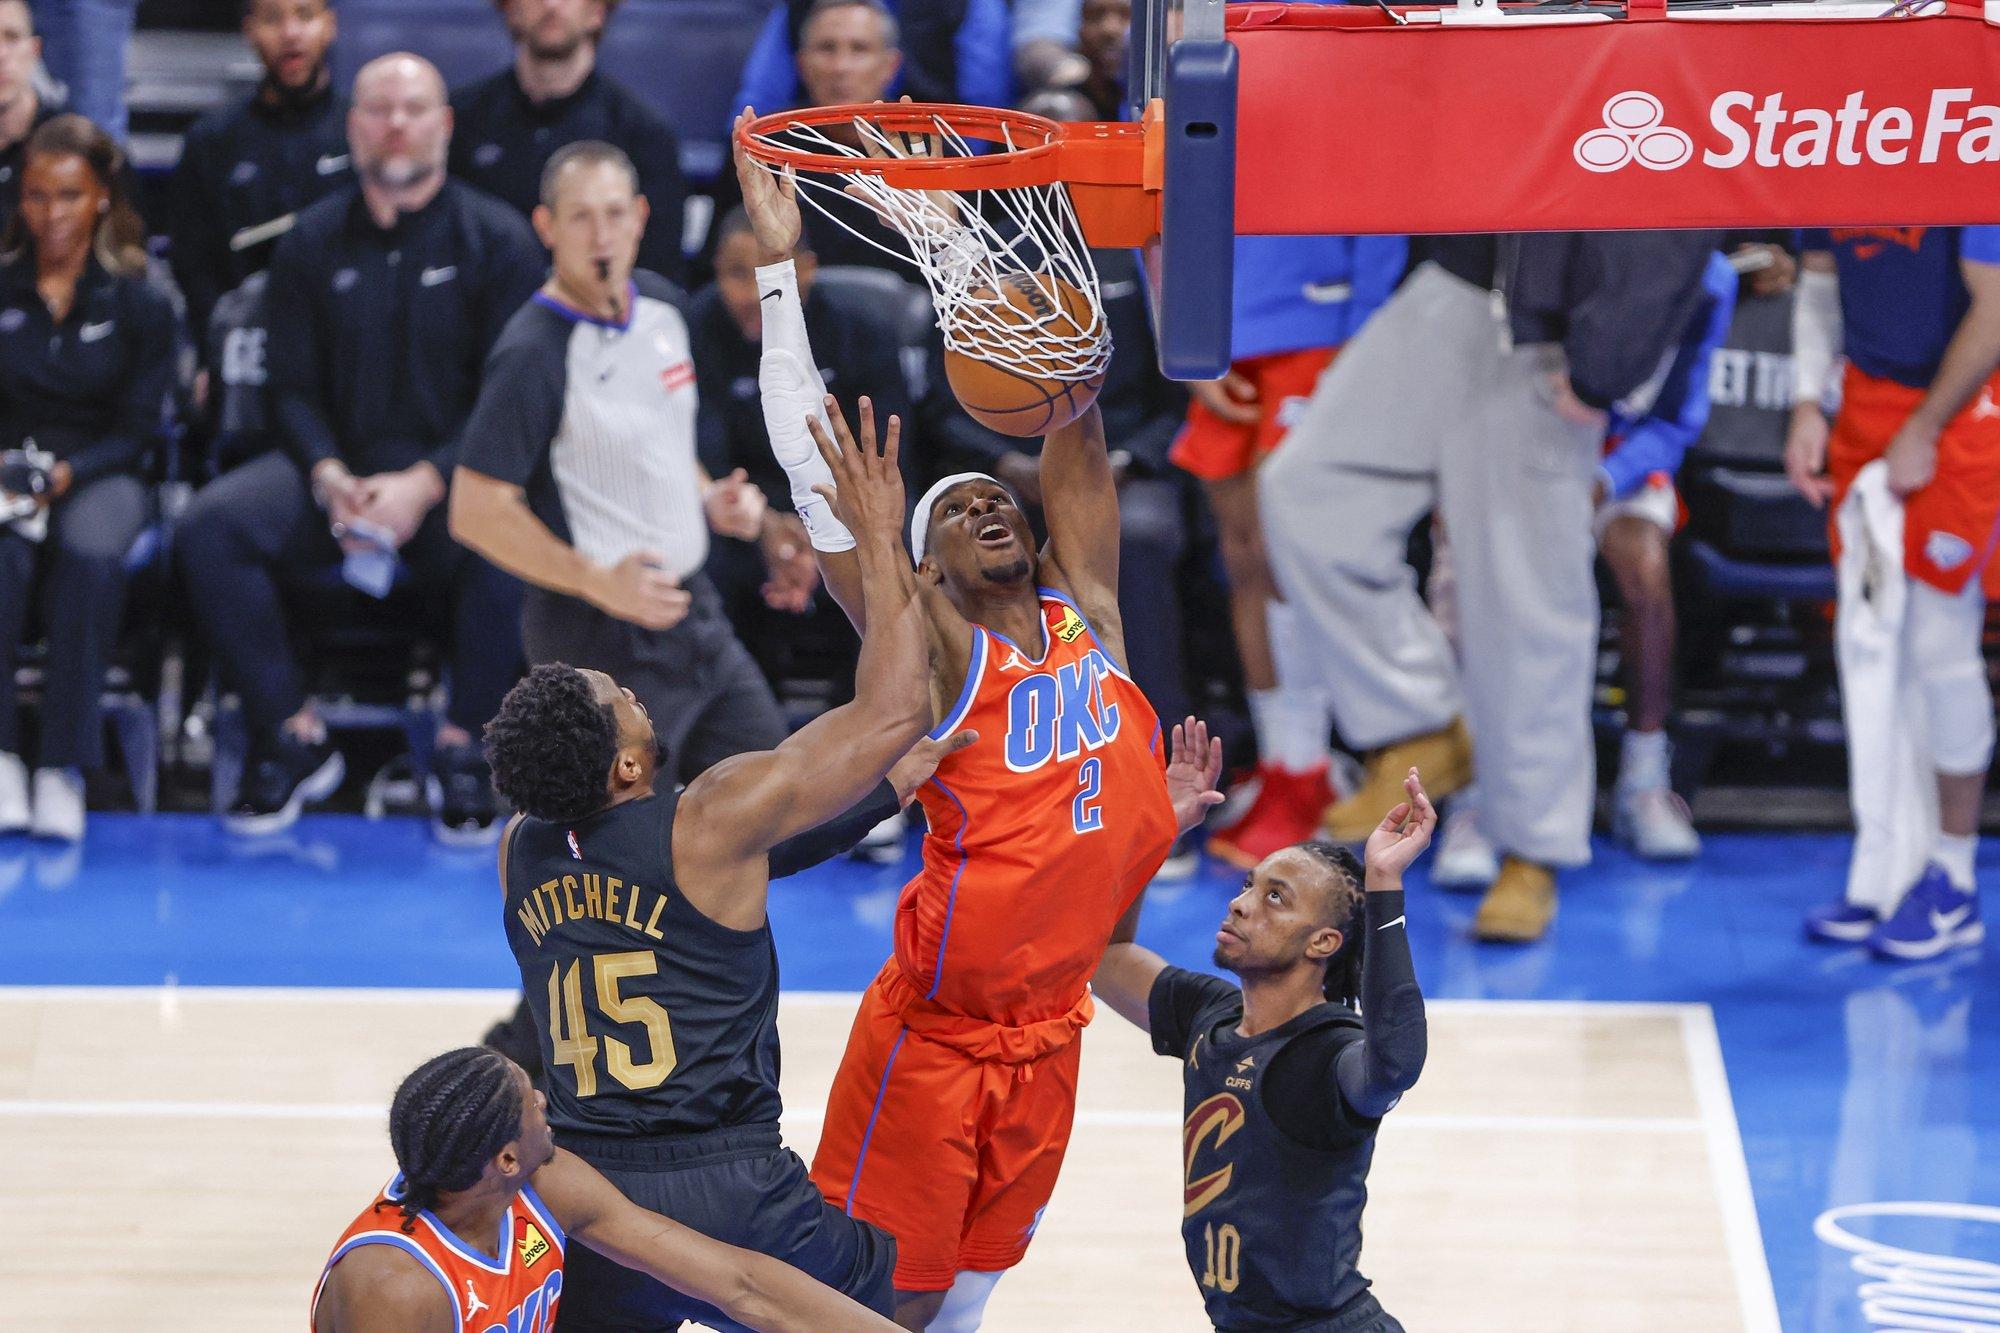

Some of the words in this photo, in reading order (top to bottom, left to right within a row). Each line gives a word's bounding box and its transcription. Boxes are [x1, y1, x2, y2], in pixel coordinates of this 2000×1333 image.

[1005, 649, 1120, 773] OKC
[1072, 757, 1103, 835] 2
[518, 873, 668, 947] MITCHELL
[548, 950, 677, 1097] 45
[1203, 1221, 1241, 1293] 10
